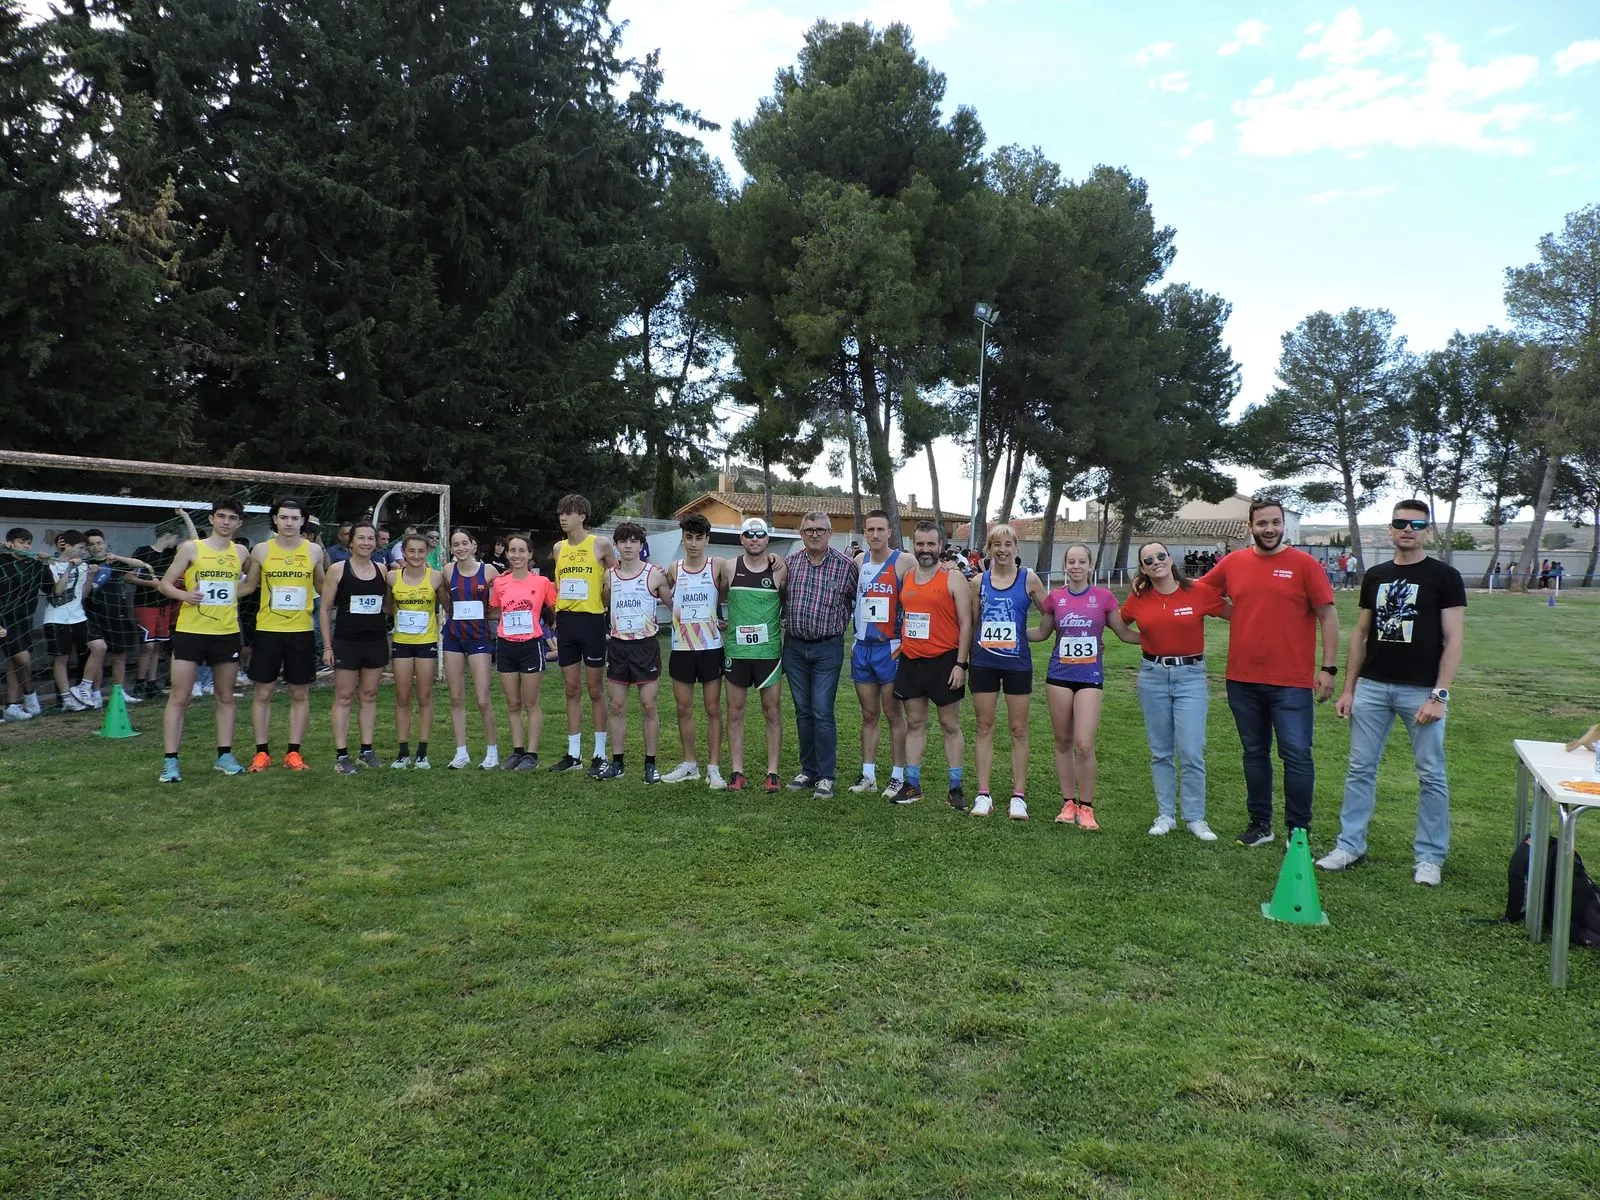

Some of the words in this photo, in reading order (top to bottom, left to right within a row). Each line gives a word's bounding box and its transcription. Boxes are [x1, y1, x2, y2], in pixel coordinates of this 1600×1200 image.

[569, 584, 575, 592] 4
[206, 589, 229, 600] 16
[682, 592, 708, 602] ARAGÓN
[359, 598, 376, 606] 149
[616, 598, 642, 609] ARAGÓN
[692, 609, 697, 618] 2
[869, 605, 876, 616] 1
[409, 617, 415, 626] 5
[511, 616, 522, 626] 11
[626, 620, 633, 630] 3
[745, 633, 759, 643] 60
[984, 627, 1012, 641] 442
[1064, 643, 1094, 657] 183
